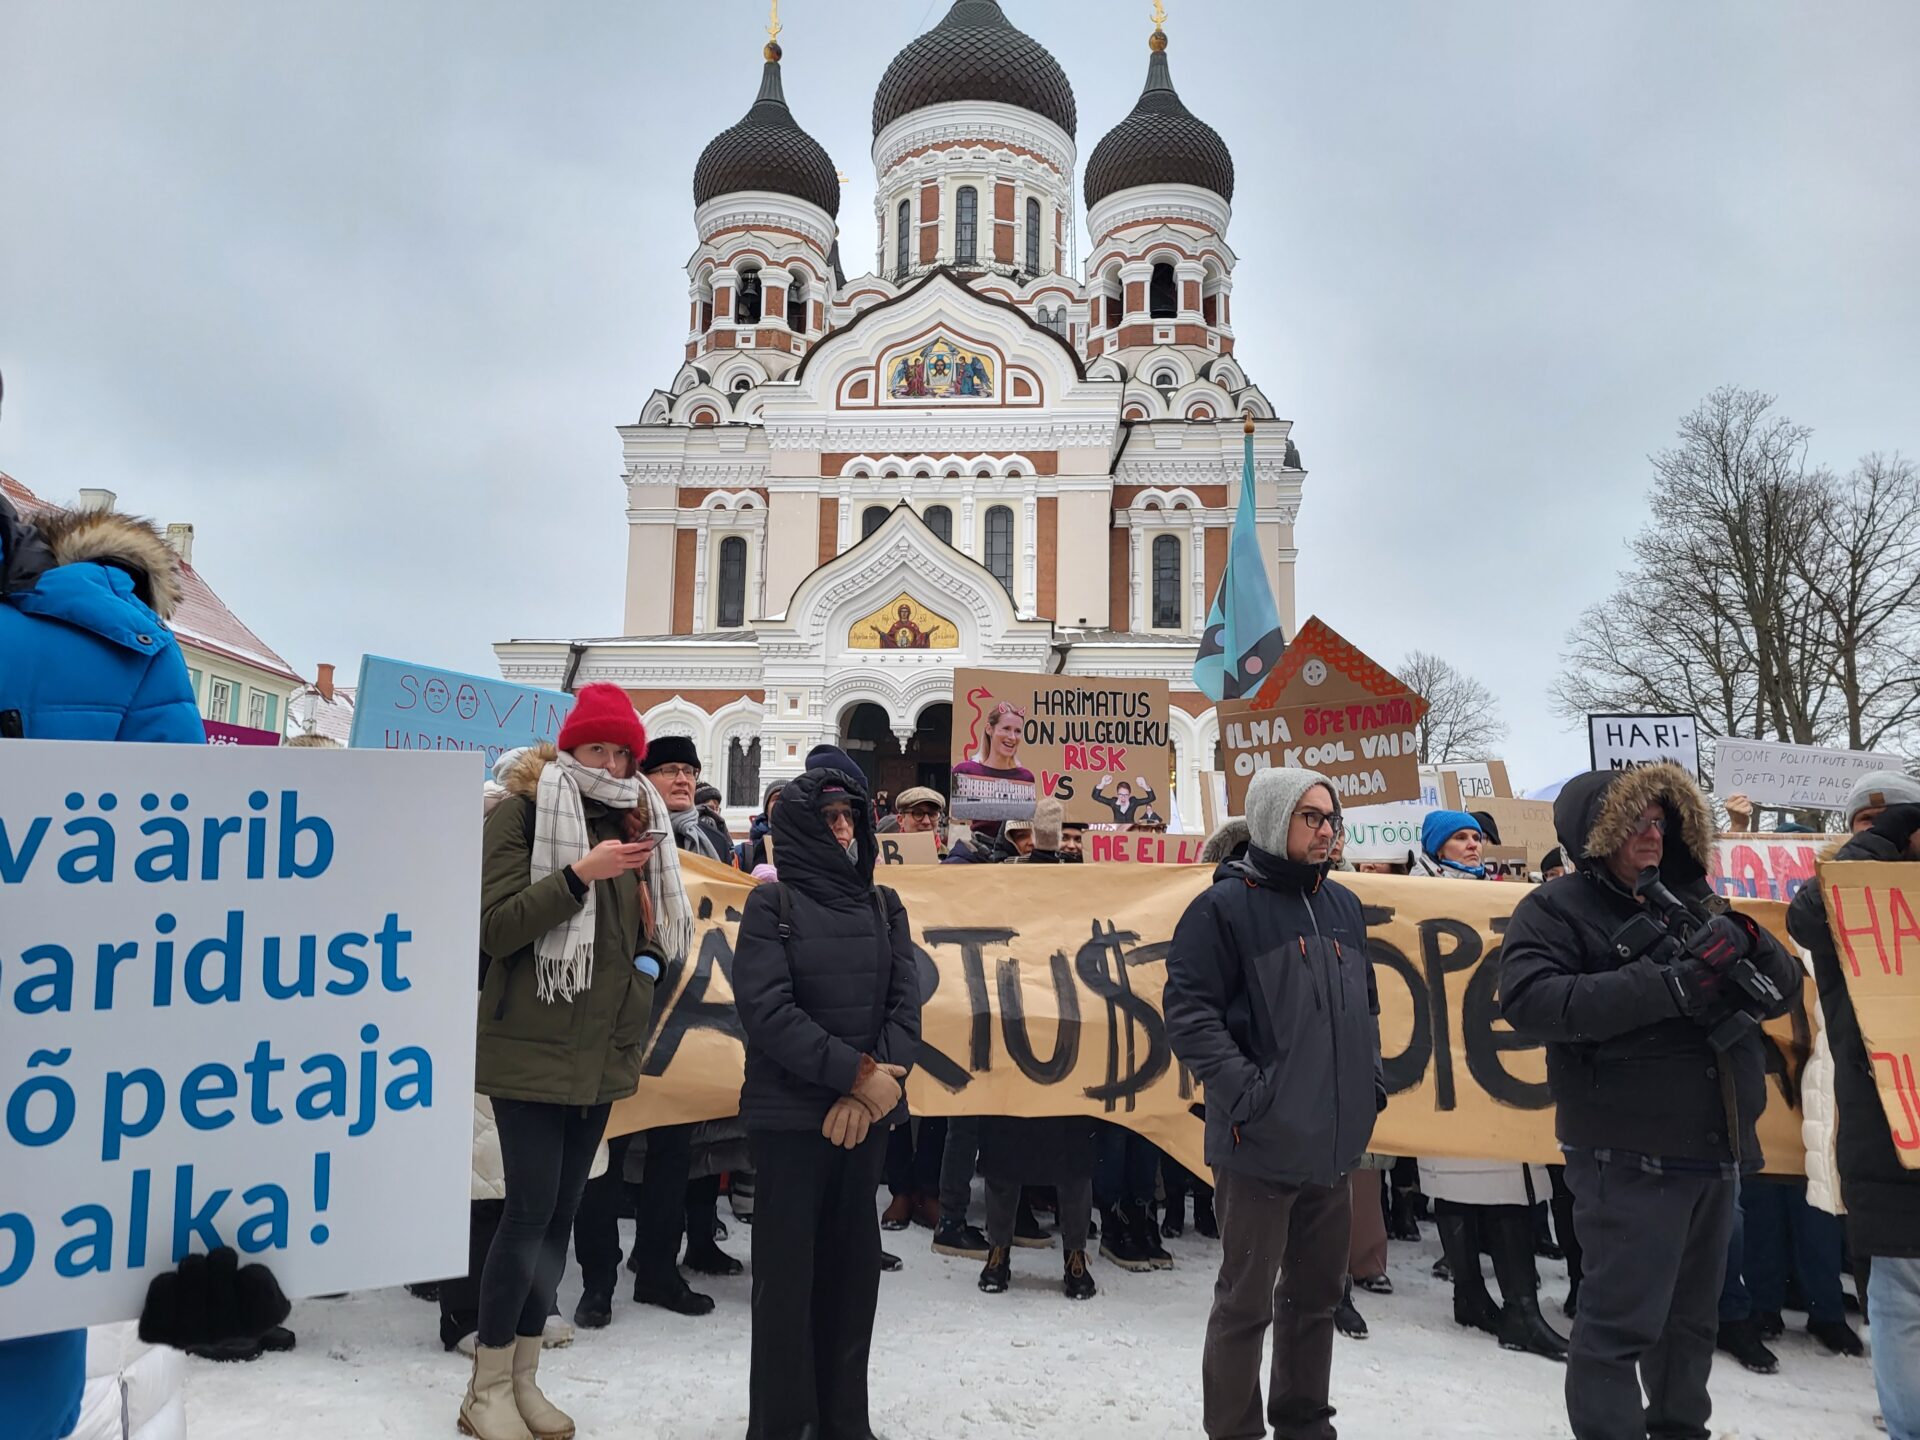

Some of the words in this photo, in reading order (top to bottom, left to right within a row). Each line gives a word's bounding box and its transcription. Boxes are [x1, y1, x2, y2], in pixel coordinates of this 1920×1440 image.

[1034, 688, 1151, 718] HARIMATUS
[1024, 720, 1055, 745] ON
[1059, 721, 1169, 747] JULGEOLEKU
[1226, 717, 1292, 749] ILMA
[1606, 723, 1689, 748] HARI-
[1064, 742, 1127, 772] RISK
[1234, 751, 1272, 776] ON
[1284, 741, 1355, 769] KOOL
[1360, 731, 1417, 759] VAID
[1852, 758, 1884, 771] TASUD
[1041, 770, 1074, 800] VS
[1818, 776, 1855, 788] PALG
[0, 790, 334, 884] väärib
[1092, 835, 1130, 862] ME
[1136, 837, 1165, 863] EI
[0, 910, 412, 1015] aridust
[6, 1024, 433, 1161] õpetaja
